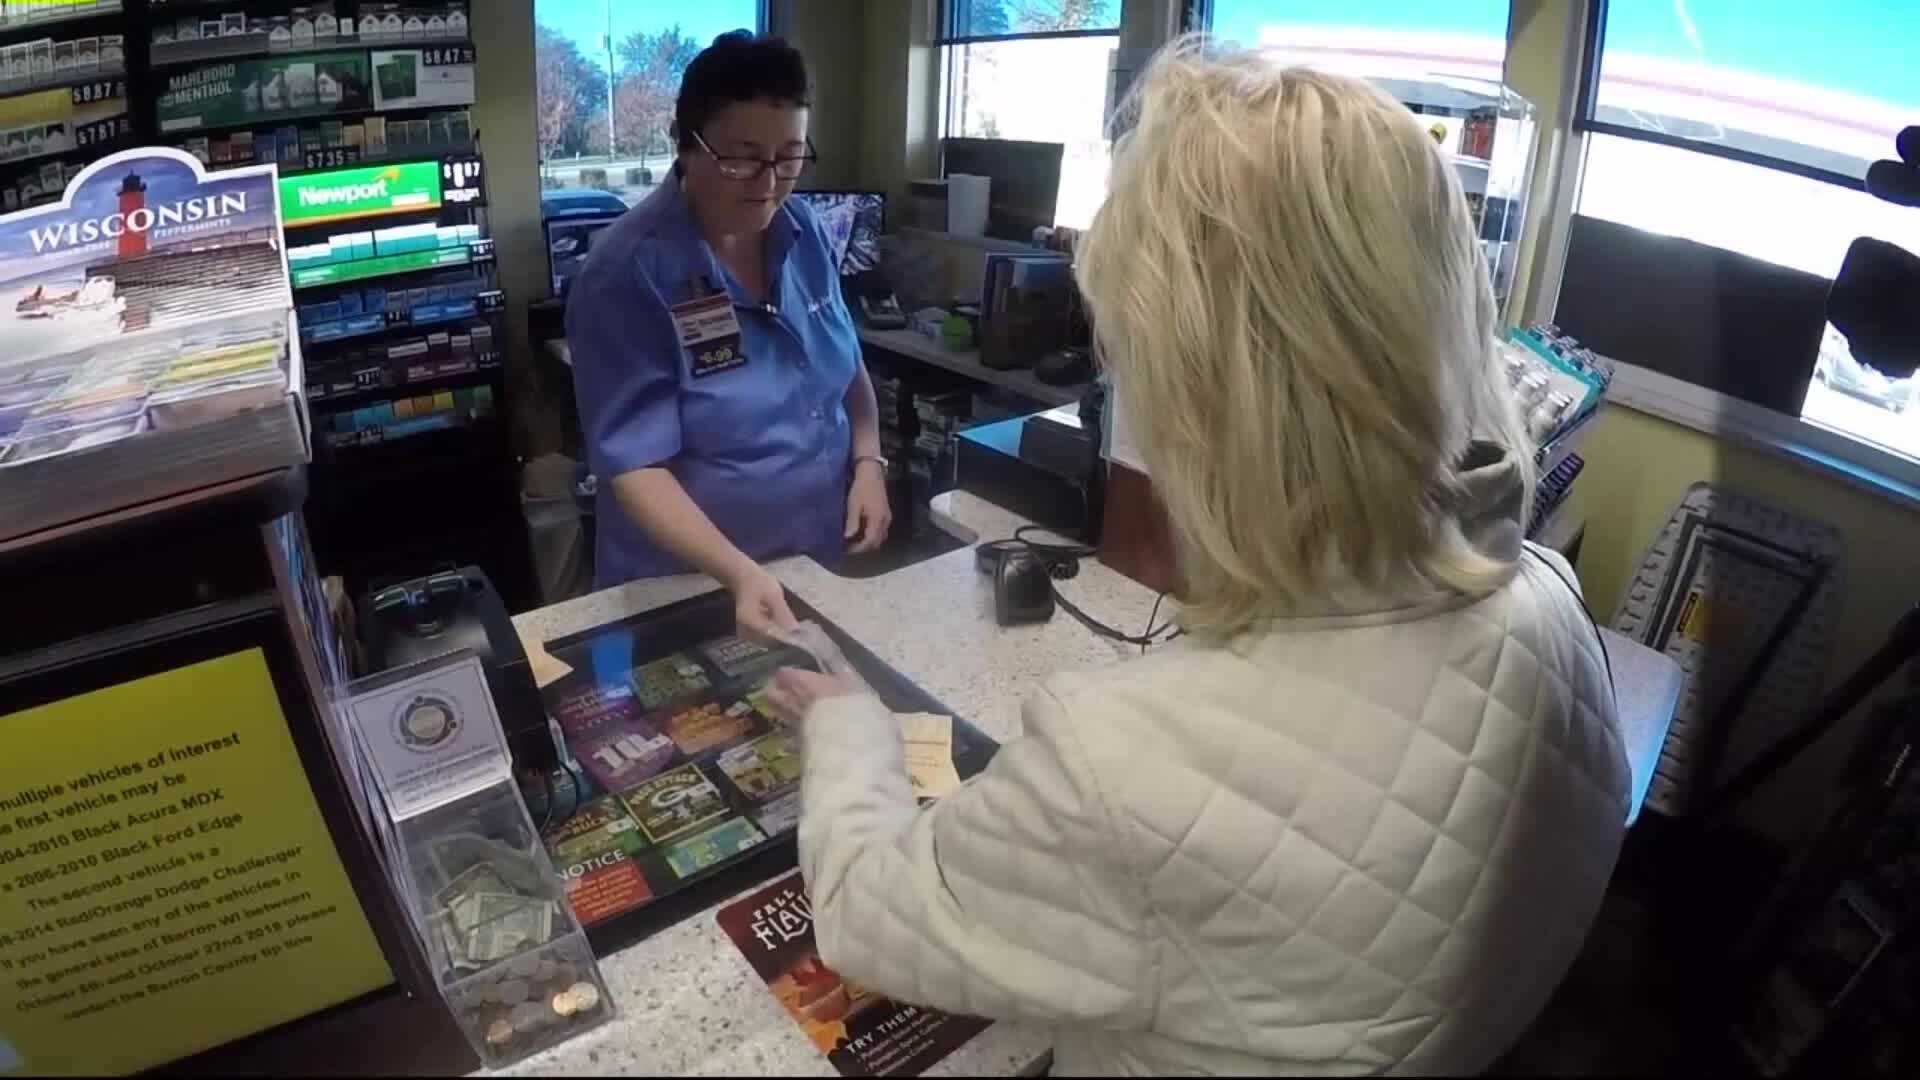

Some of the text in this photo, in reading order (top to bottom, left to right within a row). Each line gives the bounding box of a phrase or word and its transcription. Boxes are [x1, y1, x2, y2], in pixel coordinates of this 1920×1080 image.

[168, 63, 236, 91] MARLBORO
[175, 79, 232, 104] MENTHOL
[298, 179, 389, 206] Newport
[29, 191, 249, 253] WISCONSIN
[154, 218, 232, 239] PEPPERMINTS
[68, 762, 143, 791] vehicles
[148, 752, 165, 768] of
[169, 732, 240, 761] interest
[15, 773, 186, 829] first vehicle may be
[72, 819, 121, 842] Black
[128, 803, 178, 826] Acura
[181, 788, 224, 809] MDX
[15, 854, 97, 887] 2006-2010
[100, 840, 150, 862] Black
[152, 826, 194, 847] Ford
[198, 813, 242, 833] Edge
[26, 847, 220, 910] The second vehicle is a
[55, 894, 152, 927] Red/Orange
[155, 875, 209, 899] Dodge
[212, 846, 303, 880] Challenger
[753, 889, 795, 920] FALL
[16, 952, 46, 968] you
[131, 915, 160, 930] any
[164, 907, 181, 920] of
[184, 900, 211, 914] the
[216, 878, 281, 904] vehicles
[284, 871, 301, 882] in
[161, 922, 216, 945] Barron
[218, 911, 241, 926] WI
[242, 891, 312, 919] between
[203, 952, 257, 976] County
[261, 943, 282, 958] tip
[845, 1032, 874, 1053] TRY
[876, 1006, 918, 1033] THEM
